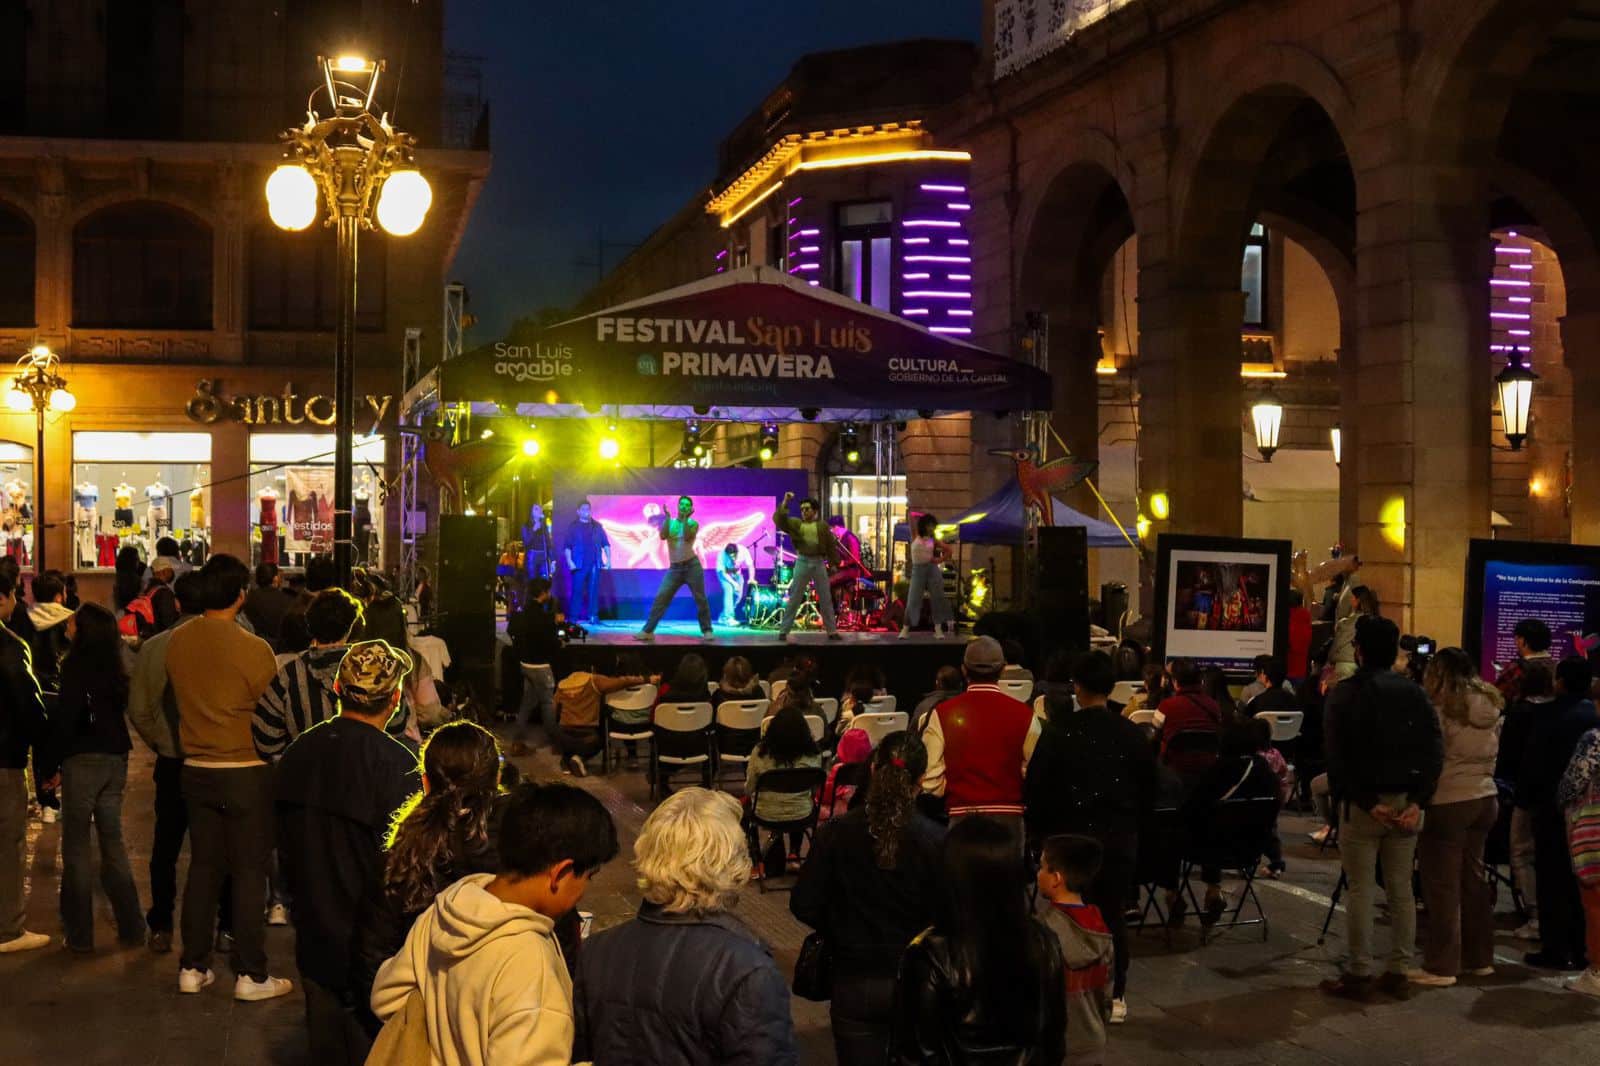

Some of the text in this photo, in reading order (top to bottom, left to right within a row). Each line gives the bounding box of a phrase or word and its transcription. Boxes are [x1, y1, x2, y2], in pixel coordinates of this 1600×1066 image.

[596, 316, 873, 355] FESTIVAL San Luis
[494, 342, 572, 360] San Luis
[662, 351, 835, 379] PRIMAVERA
[941, 374, 954, 383] DE
[957, 374, 969, 384] LA
[185, 379, 393, 431] Santoy
